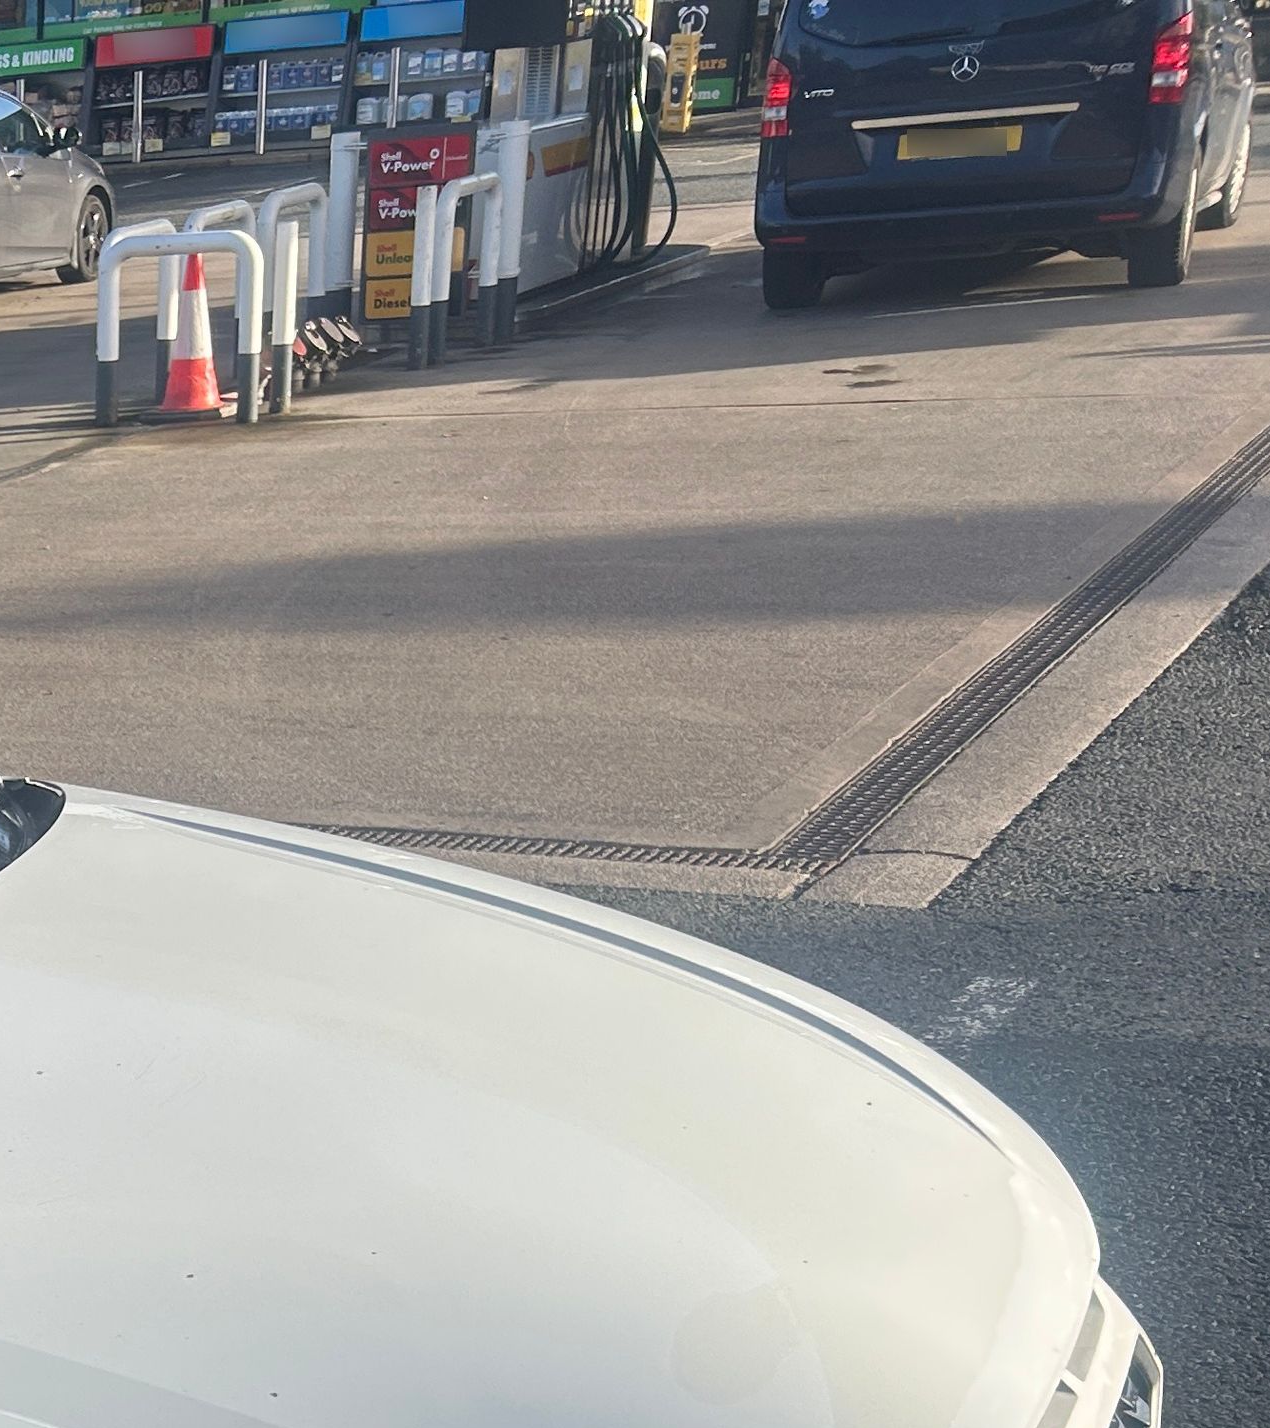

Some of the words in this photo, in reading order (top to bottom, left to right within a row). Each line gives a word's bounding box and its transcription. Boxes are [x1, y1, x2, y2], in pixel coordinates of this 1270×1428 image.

[11, 53, 19, 68] &
[22, 47, 74, 67] KINDLING
[380, 151, 402, 162] Shell
[380, 160, 436, 174] V-Power
[378, 198, 400, 208] Shell
[378, 207, 418, 220] V-Pow
[375, 253, 413, 265] Unlea
[373, 297, 412, 309] Diesel
